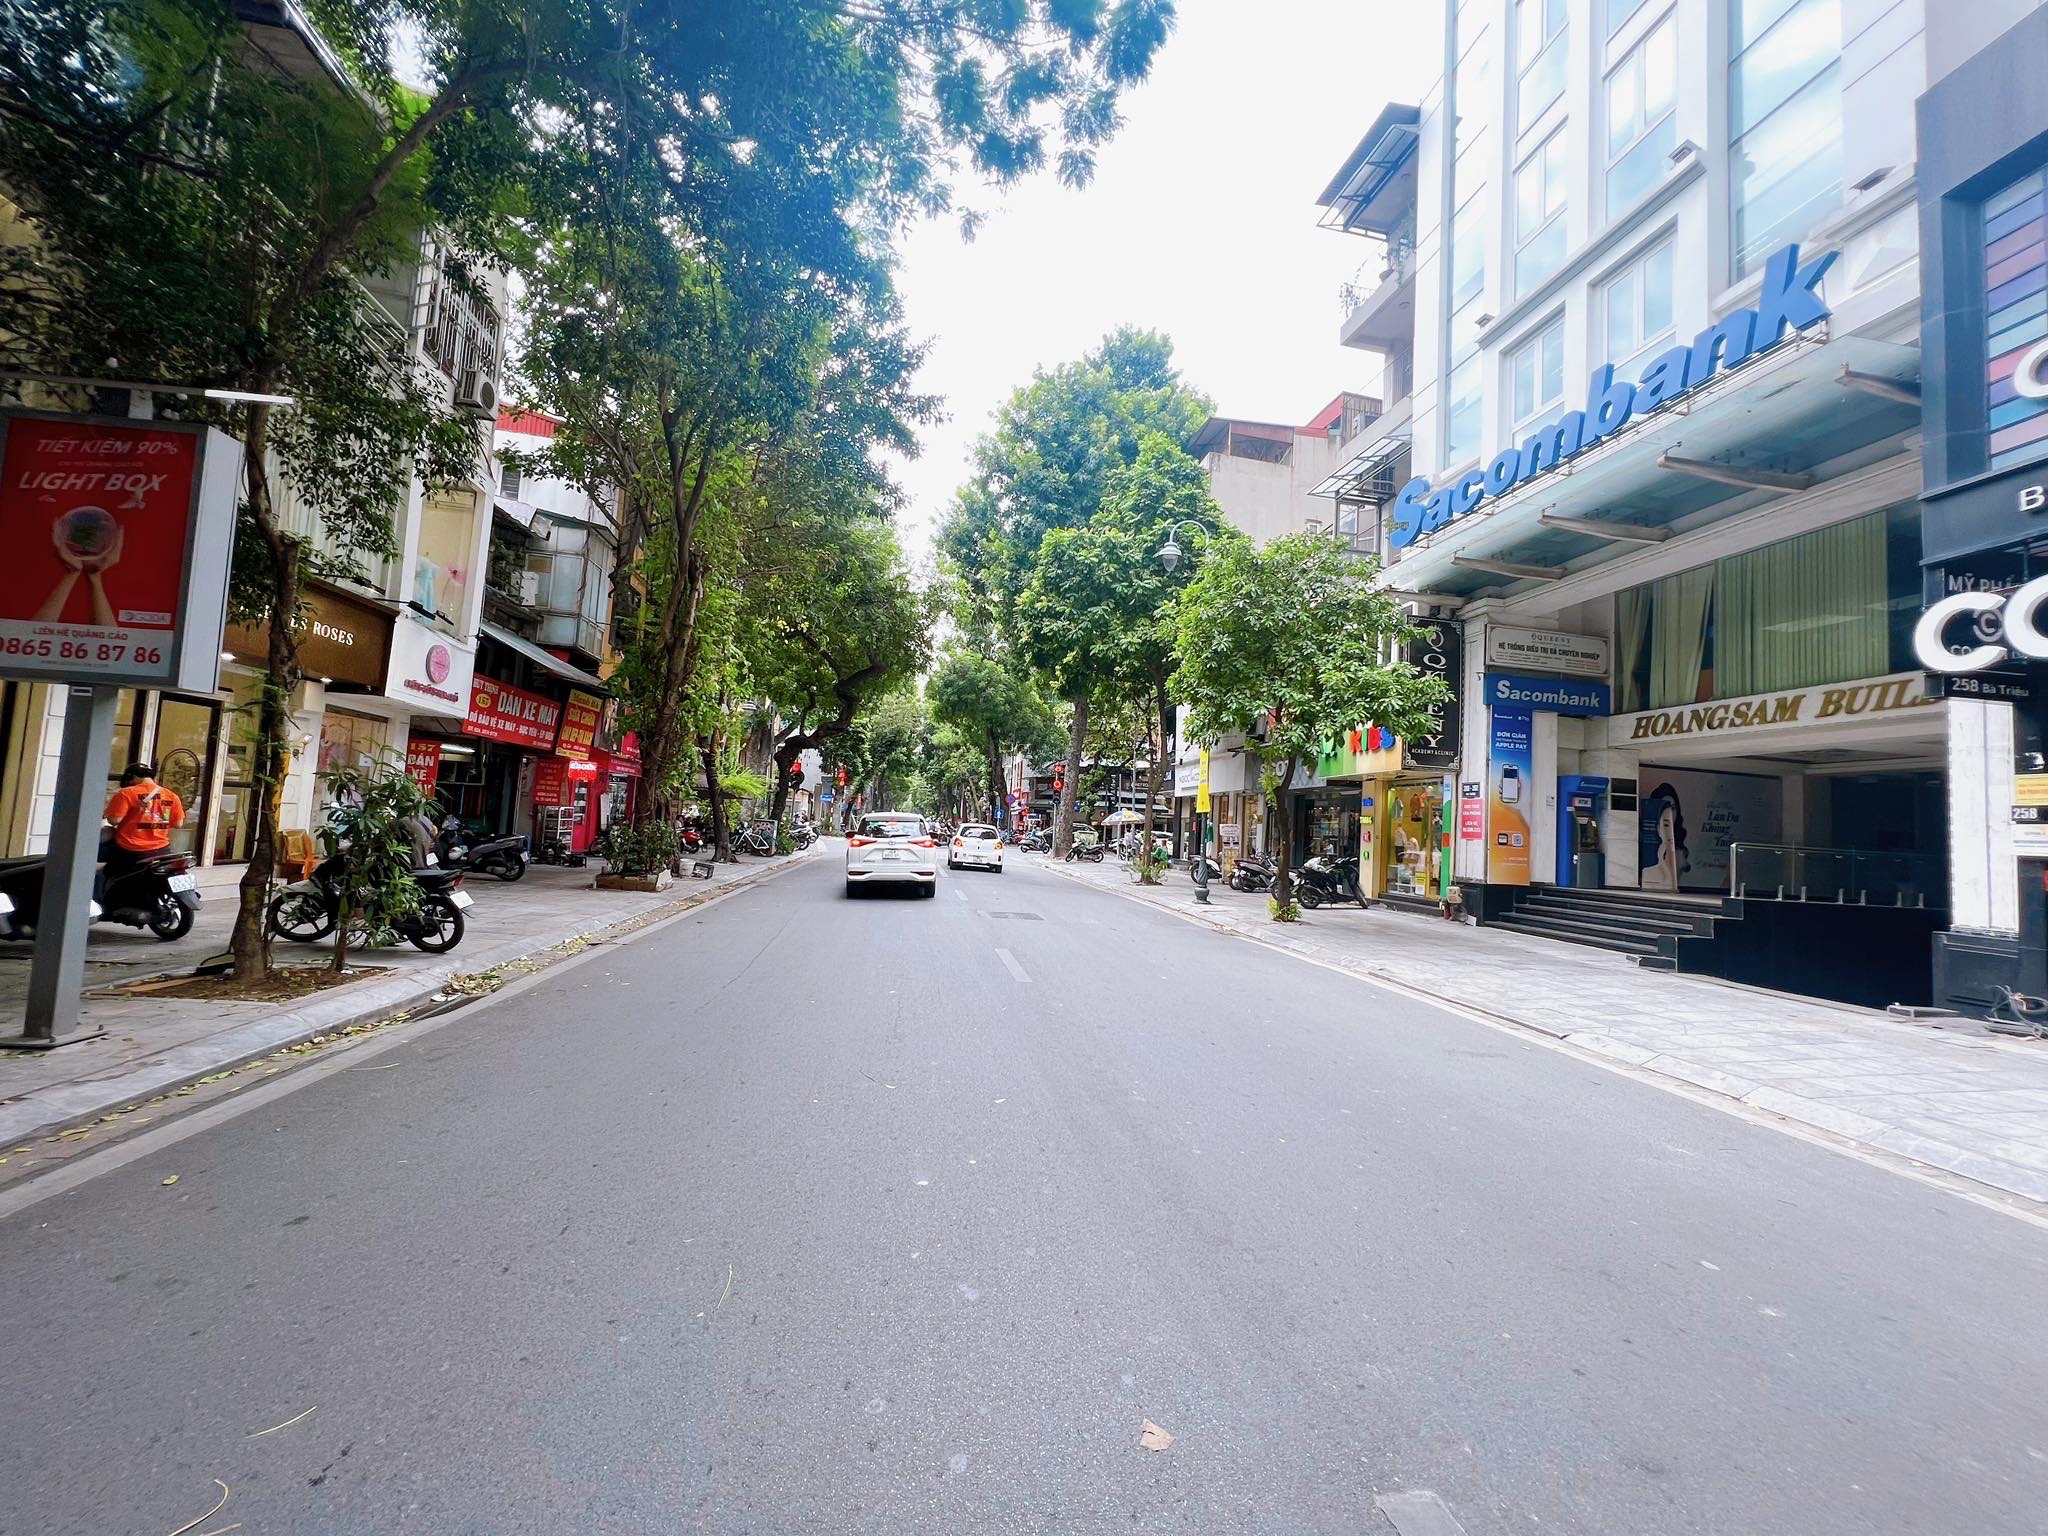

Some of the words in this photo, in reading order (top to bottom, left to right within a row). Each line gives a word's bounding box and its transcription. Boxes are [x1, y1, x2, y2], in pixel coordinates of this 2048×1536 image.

[1388, 243, 1840, 549] Sacombank
[37, 436, 79, 453] TIẾT
[80, 438, 129, 456] KIỆM
[136, 441, 178, 455] 90%
[18, 471, 104, 491] LIGHT
[104, 473, 168, 492] BOX
[1948, 573, 1975, 592] MỸ
[72, 630, 105, 640] QUẢNG
[108, 632, 128, 641] CÁO
[312, 621, 354, 646] ROSES
[0, 638, 52, 656] 865
[60, 642, 88, 659] 86
[97, 644, 126, 662] 87
[133, 647, 161, 664] 86
[1558, 648, 1580, 658] CHUYÊN
[1496, 680, 1600, 708] Sacombank
[1952, 678, 1979, 692] 258
[497, 691, 522, 717] DÁN
[523, 700, 538, 721] XE
[538, 703, 558, 726] MÁY
[1630, 693, 1805, 740] HOANGSAM
[497, 720, 505, 729] XE
[410, 742, 436, 751] 157
[1349, 726, 1396, 753] KIDS
[407, 752, 435, 766] DÁN
[413, 769, 427, 780] XE
[2013, 808, 2038, 819] 258
